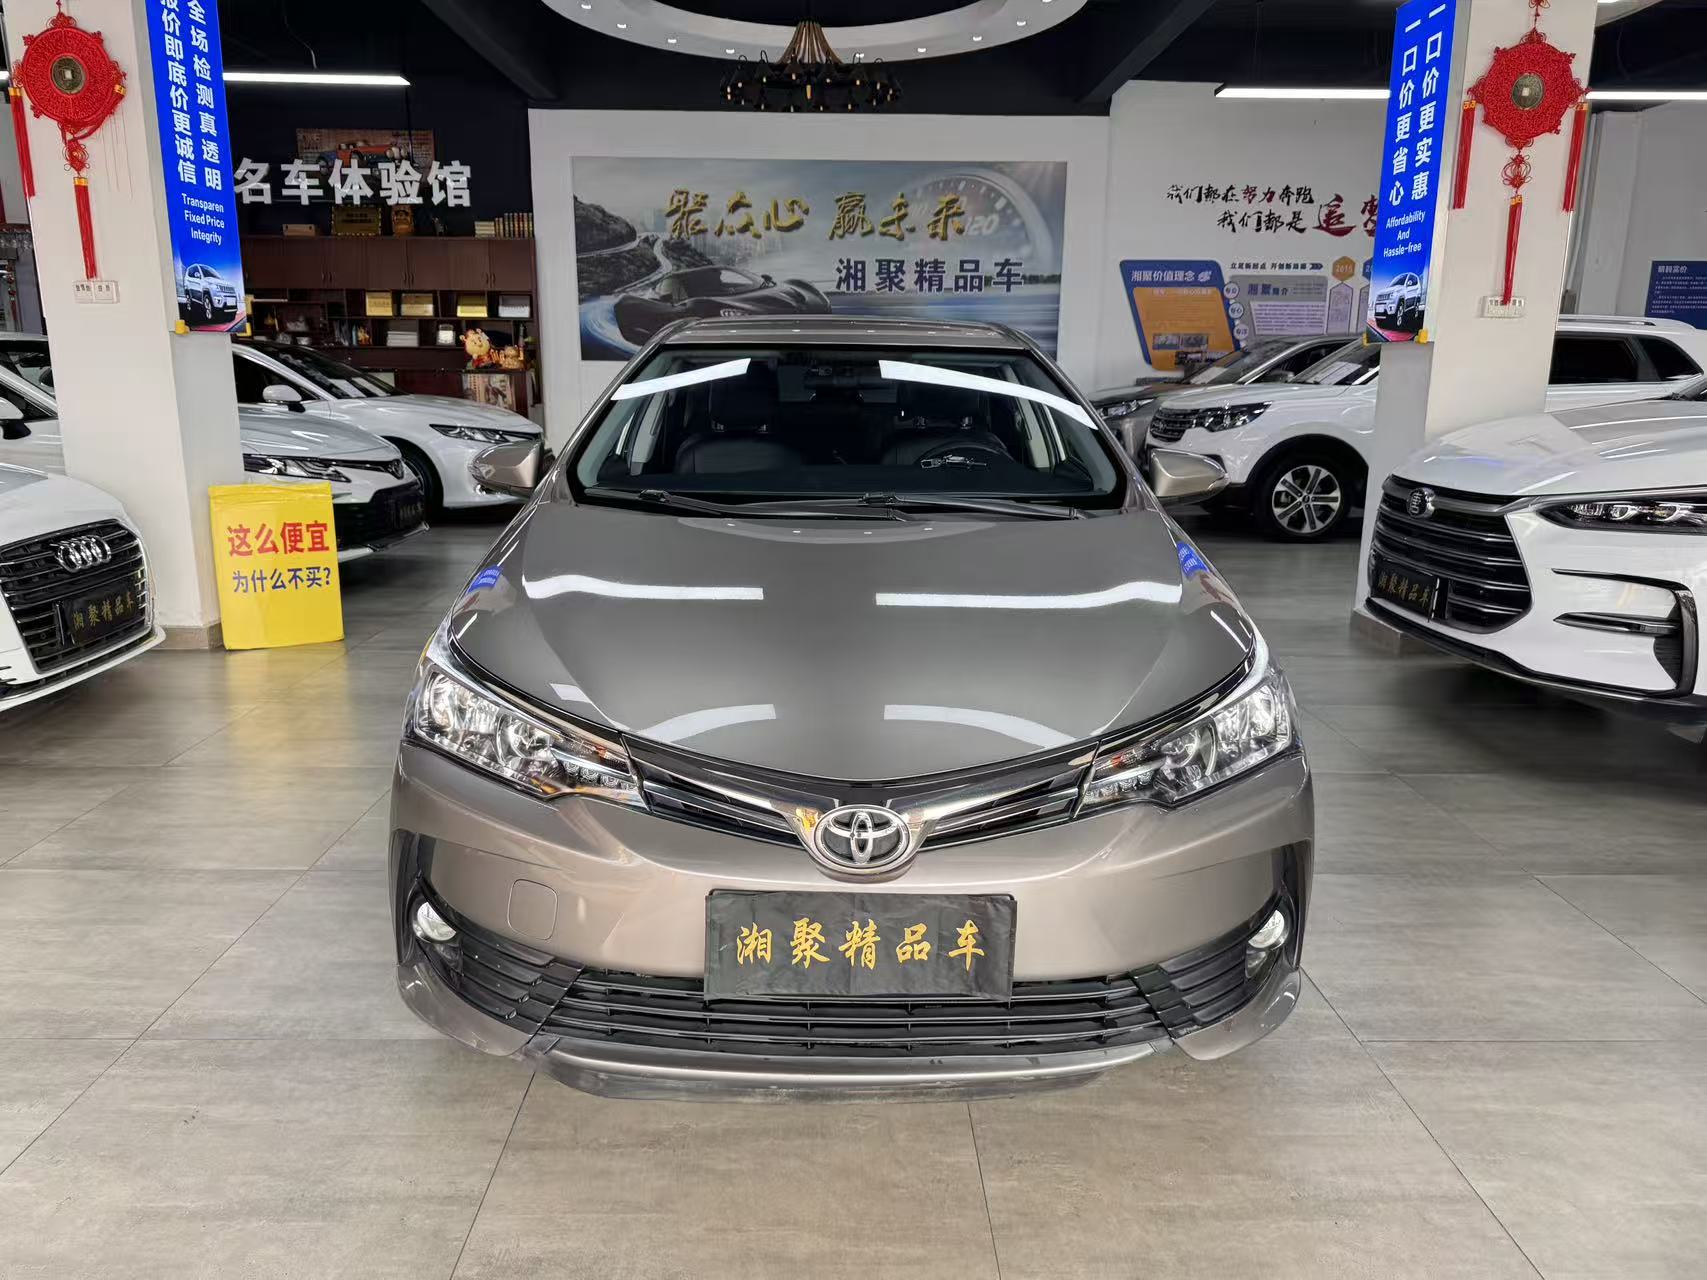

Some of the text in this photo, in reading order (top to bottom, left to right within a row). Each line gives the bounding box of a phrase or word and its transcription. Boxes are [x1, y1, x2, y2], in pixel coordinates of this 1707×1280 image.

[187, 0, 223, 190] 全场检测真透明
[1411, 3, 1446, 200] 一口价更实惠
[1389, 19, 1422, 206] 一口价更省心
[234, 157, 471, 207] 名车体验馆
[1166, 184, 1315, 206] 我们都在努力奔跑
[181, 193, 225, 213] Transparen
[184, 209, 225, 229] Fixed Price
[1385, 209, 1426, 229] Affordability
[190, 227, 222, 246] Integrity
[1396, 227, 1411, 241] And
[1383, 241, 1423, 258] Hassle-free
[834, 257, 1025, 293] 湘聚精品车
[227, 520, 330, 557] 这么便宜
[736, 917, 985, 972] 湘聚精品车
